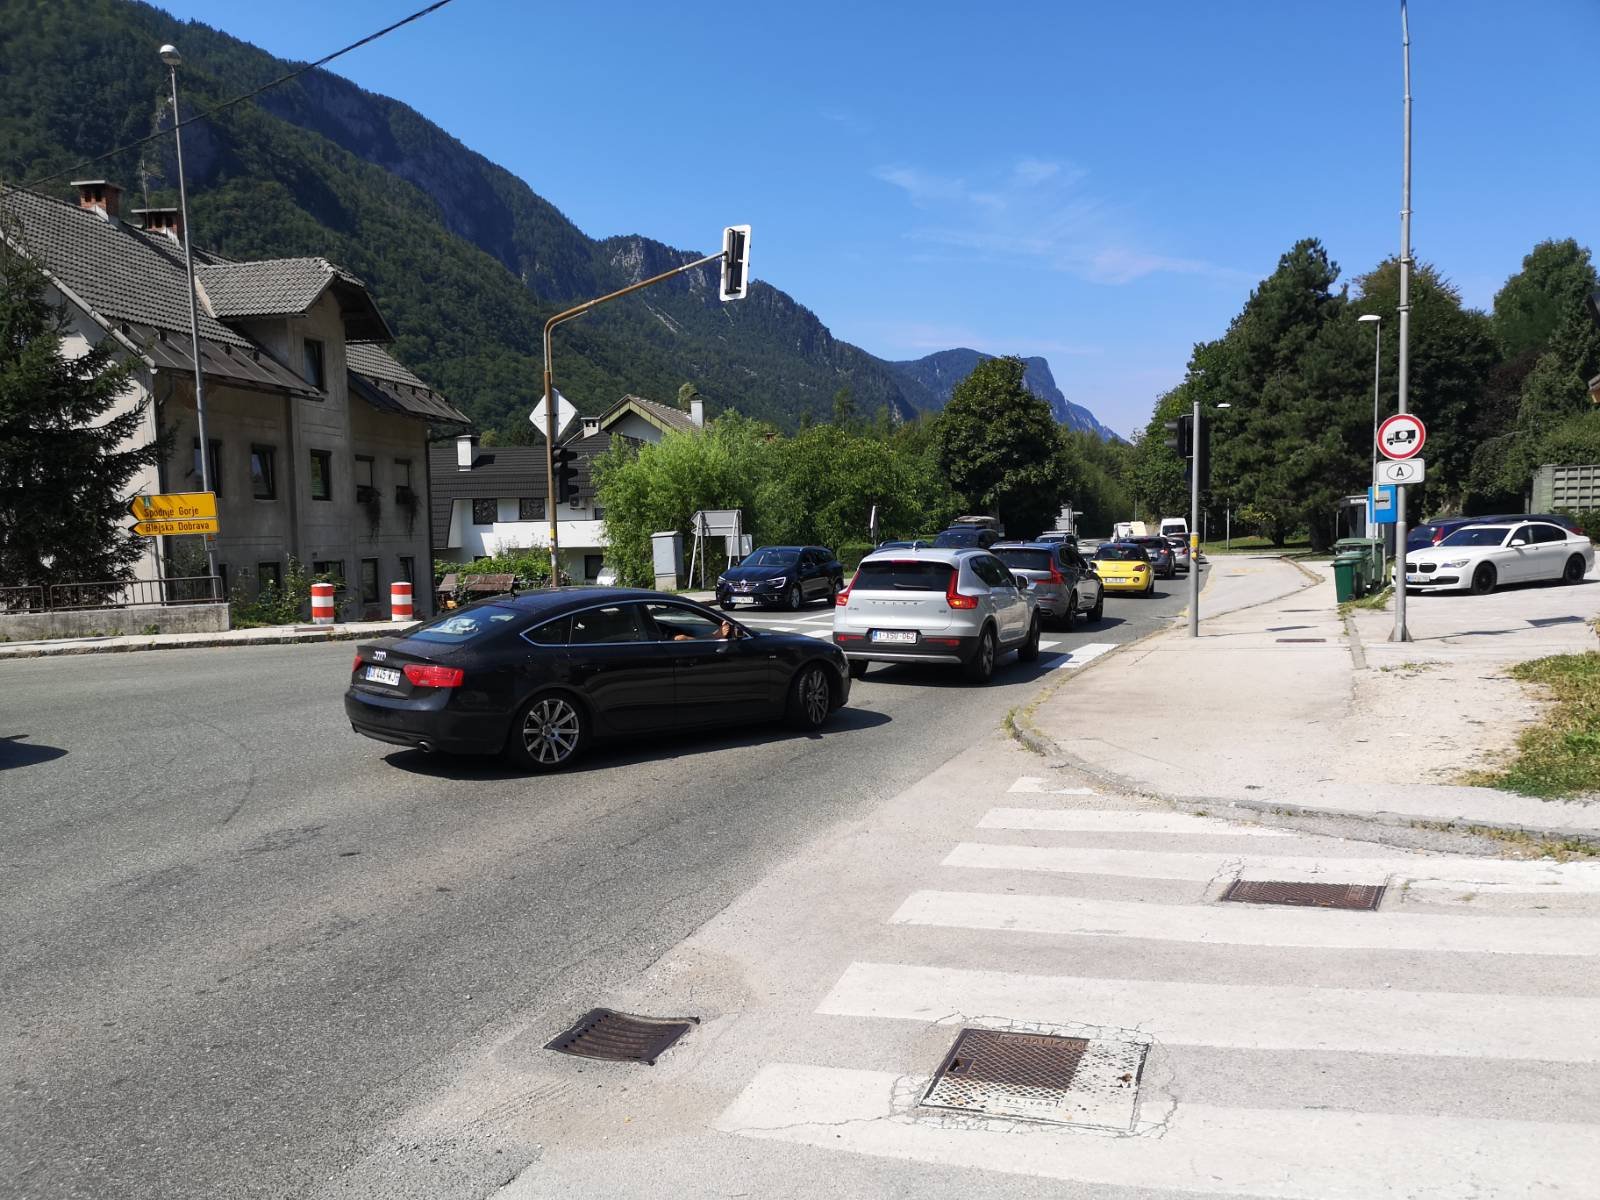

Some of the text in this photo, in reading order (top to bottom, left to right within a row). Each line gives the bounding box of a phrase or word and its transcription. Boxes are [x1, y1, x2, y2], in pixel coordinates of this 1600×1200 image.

[1396, 466, 1405, 477] A
[144, 507, 199, 518] Spodnje Gorje
[145, 522, 210, 533] Blejska Dobrava
